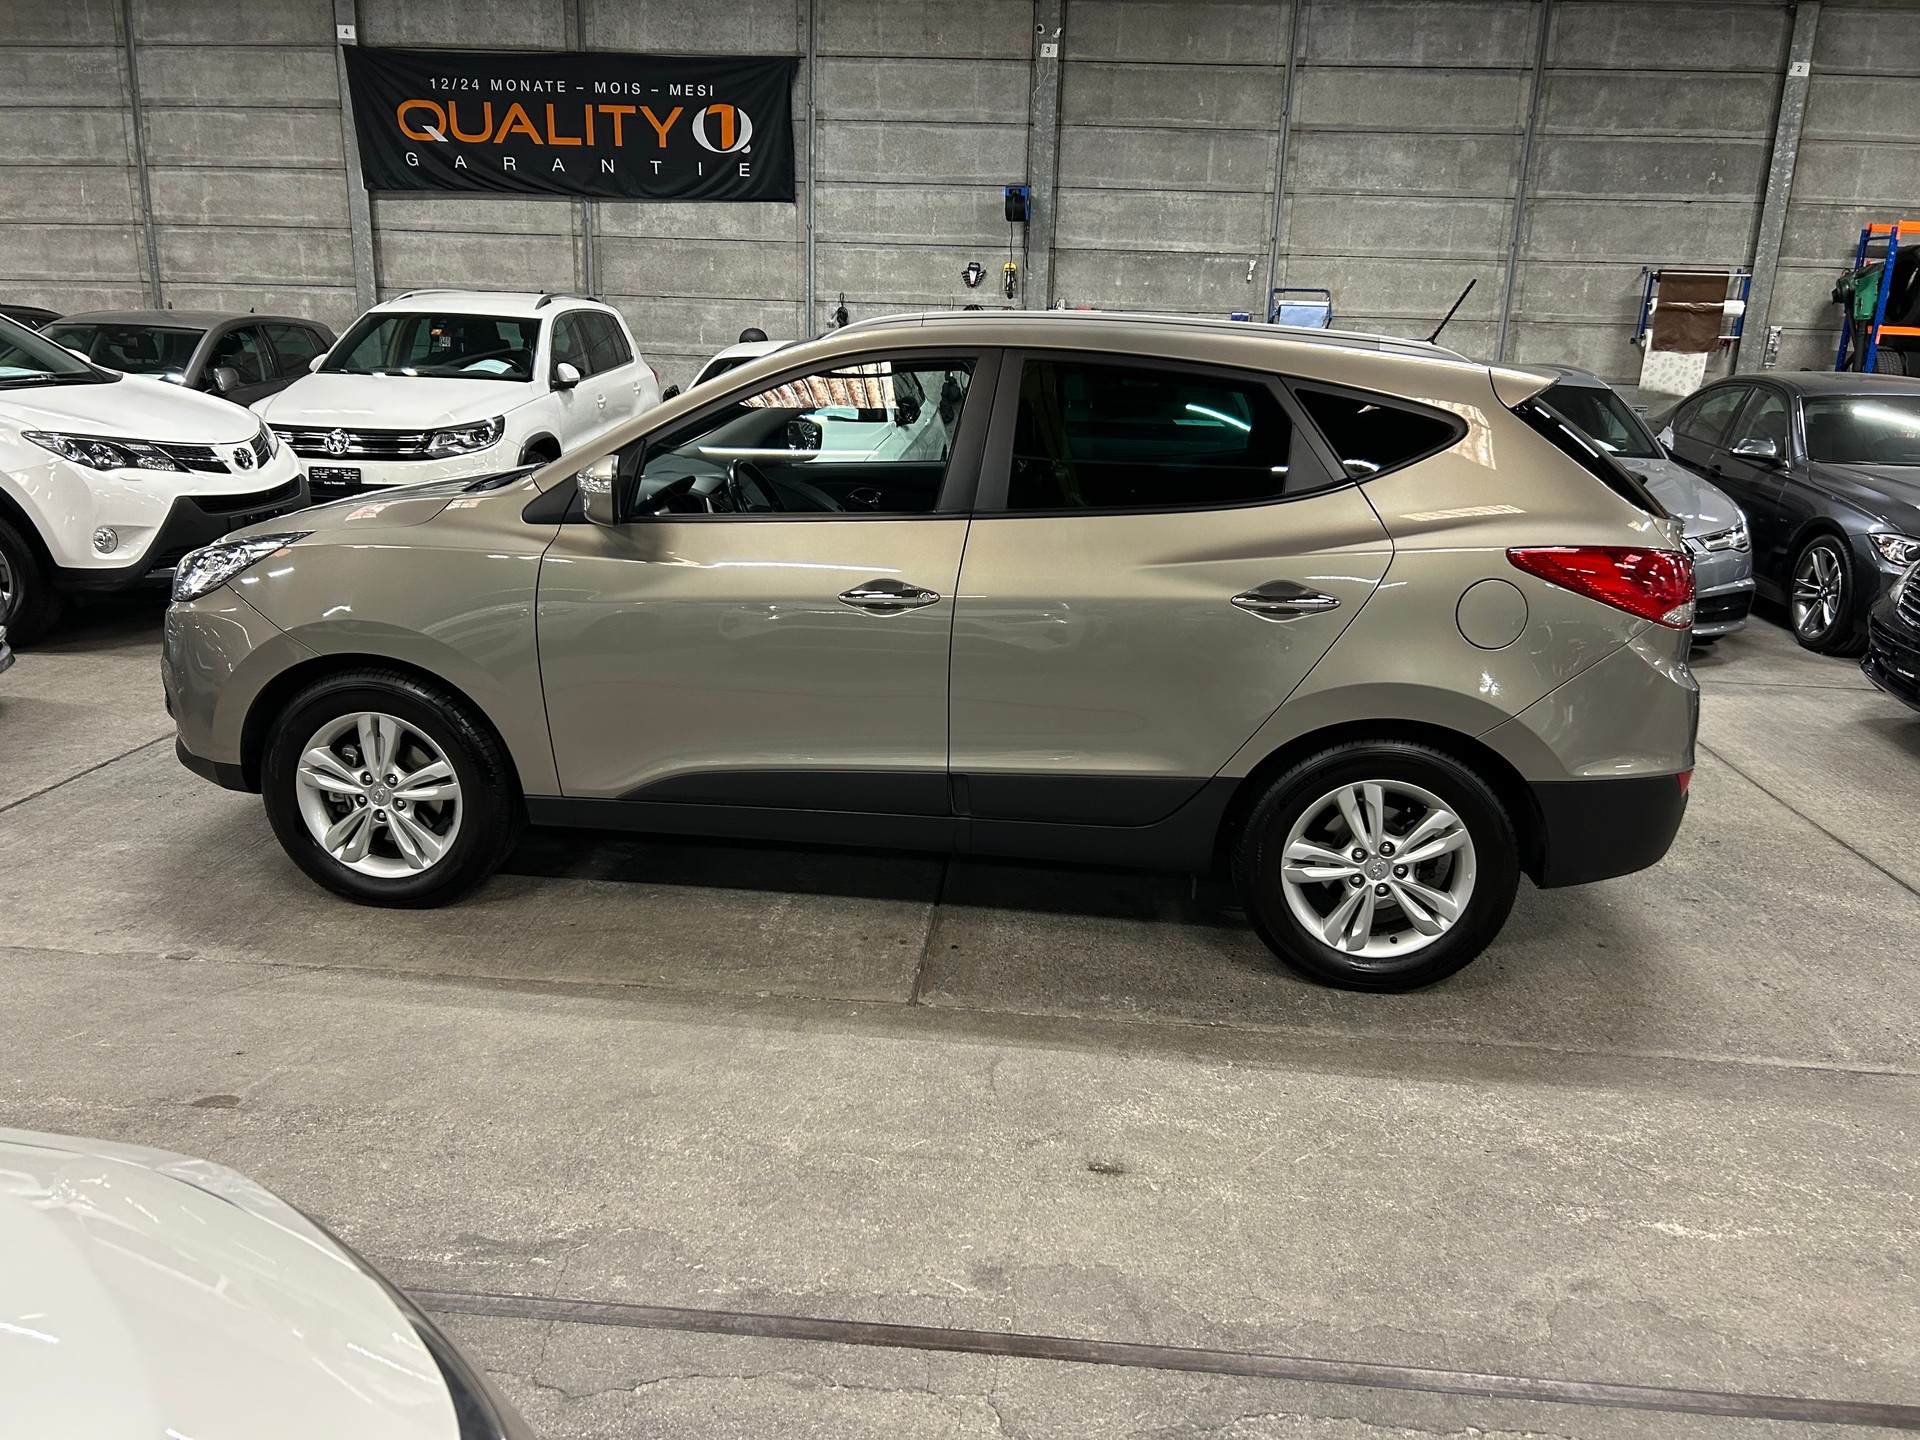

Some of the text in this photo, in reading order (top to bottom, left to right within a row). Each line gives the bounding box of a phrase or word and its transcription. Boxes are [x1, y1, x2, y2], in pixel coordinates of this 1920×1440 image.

[429, 77, 480, 91] 12/24
[490, 78, 567, 93] MONATE
[594, 81, 641, 95] MOIS
[669, 83, 713, 97] MESI
[396, 99, 684, 148] QUALITY
[405, 152, 751, 177] GARANTIE
